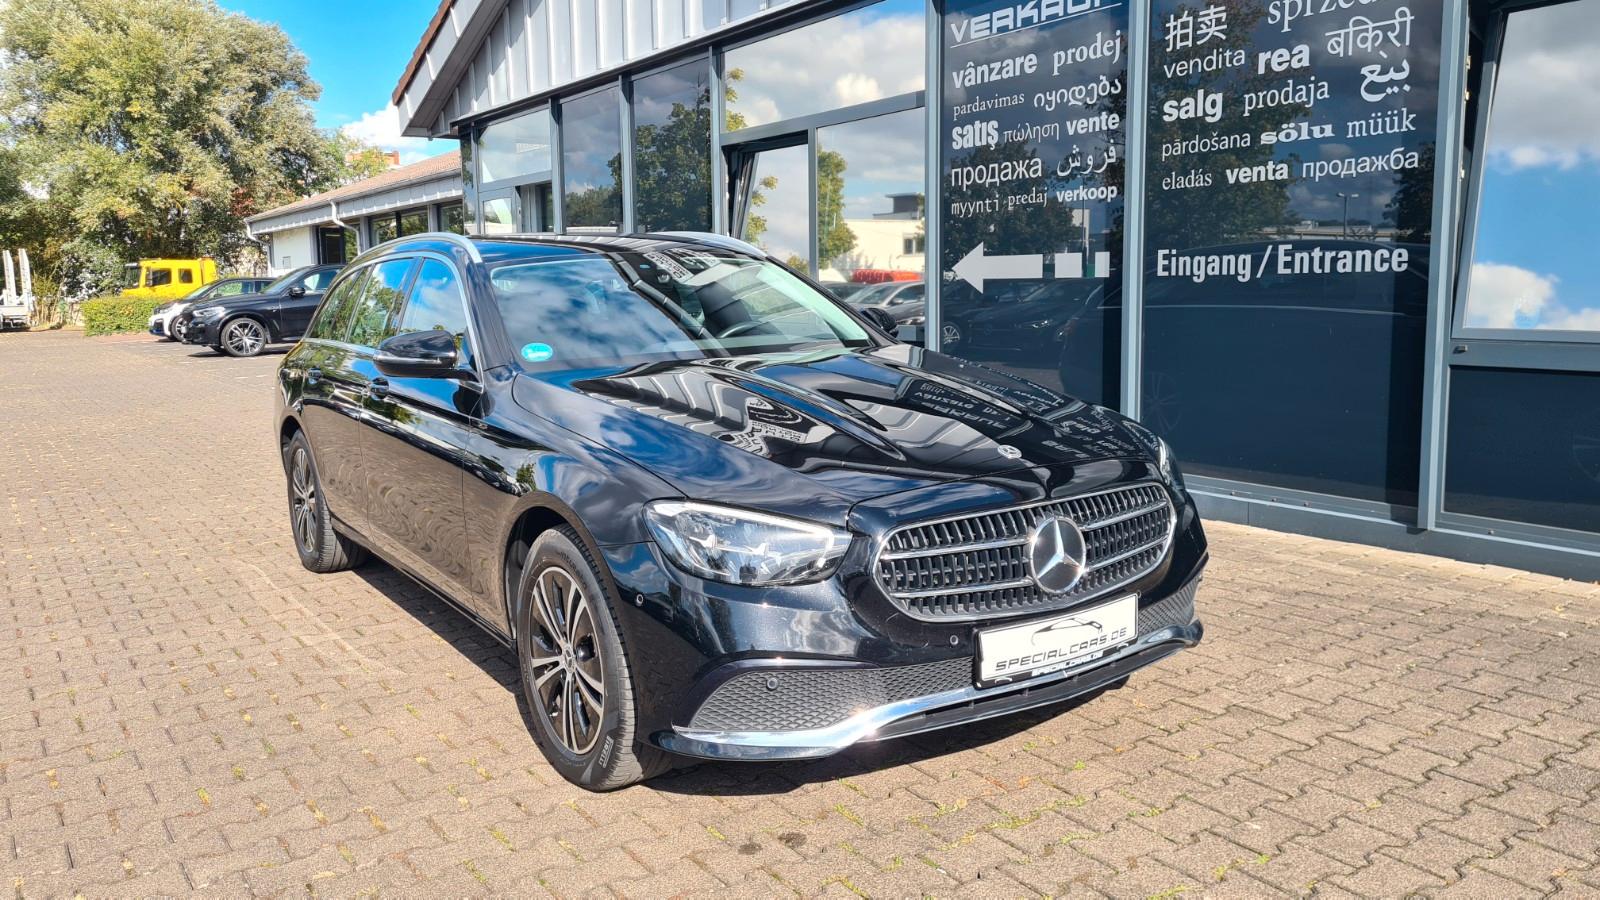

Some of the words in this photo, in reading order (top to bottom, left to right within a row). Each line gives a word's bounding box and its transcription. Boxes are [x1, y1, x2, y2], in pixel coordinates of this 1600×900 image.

[1165, 4, 1228, 52] 拍卖
[952, 53, 1038, 89] vânzare
[1052, 29, 1121, 76] prodej
[1163, 49, 1245, 78] vendita
[1257, 44, 1310, 75] rea
[1033, 75, 1122, 111] იყიდება
[1360, 58, 1411, 102] بيع
[953, 93, 1025, 121] pardavimas
[1162, 89, 1223, 123] salg
[1243, 76, 1330, 117] prodaja
[952, 120, 999, 150] satış
[1003, 122, 1060, 143] πώληση
[1066, 111, 1120, 136] vente
[1161, 132, 1251, 161] pārdošana
[1260, 122, 1335, 146] sölu
[1346, 107, 1416, 139] müük
[951, 157, 1042, 192] продажа
[1056, 138, 1117, 177] فروش
[1302, 147, 1419, 182] продажба
[1162, 169, 1212, 191] eladás
[1225, 160, 1289, 184] venta
[951, 194, 999, 218] myynti
[1007, 187, 1048, 210] predaj
[1056, 185, 1118, 202] verkoop
[1156, 248, 1252, 283] Eingang
[1277, 244, 1409, 276] Entrance
